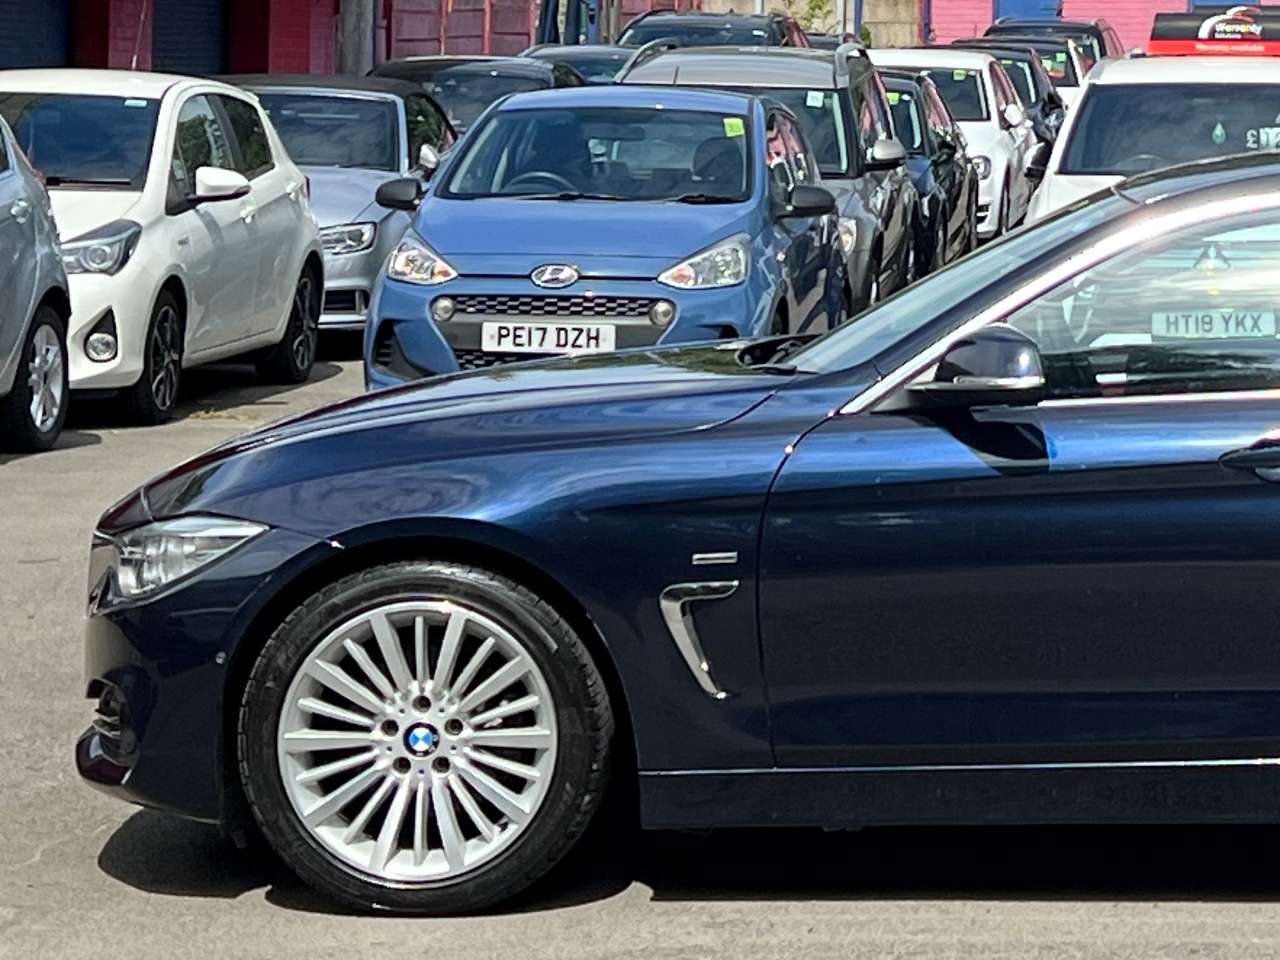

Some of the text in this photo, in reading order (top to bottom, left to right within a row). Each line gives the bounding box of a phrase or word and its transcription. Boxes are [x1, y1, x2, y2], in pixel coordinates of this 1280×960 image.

[1221, 313, 1262, 333] YKX
[497, 326, 600, 348] PE17 DZH
